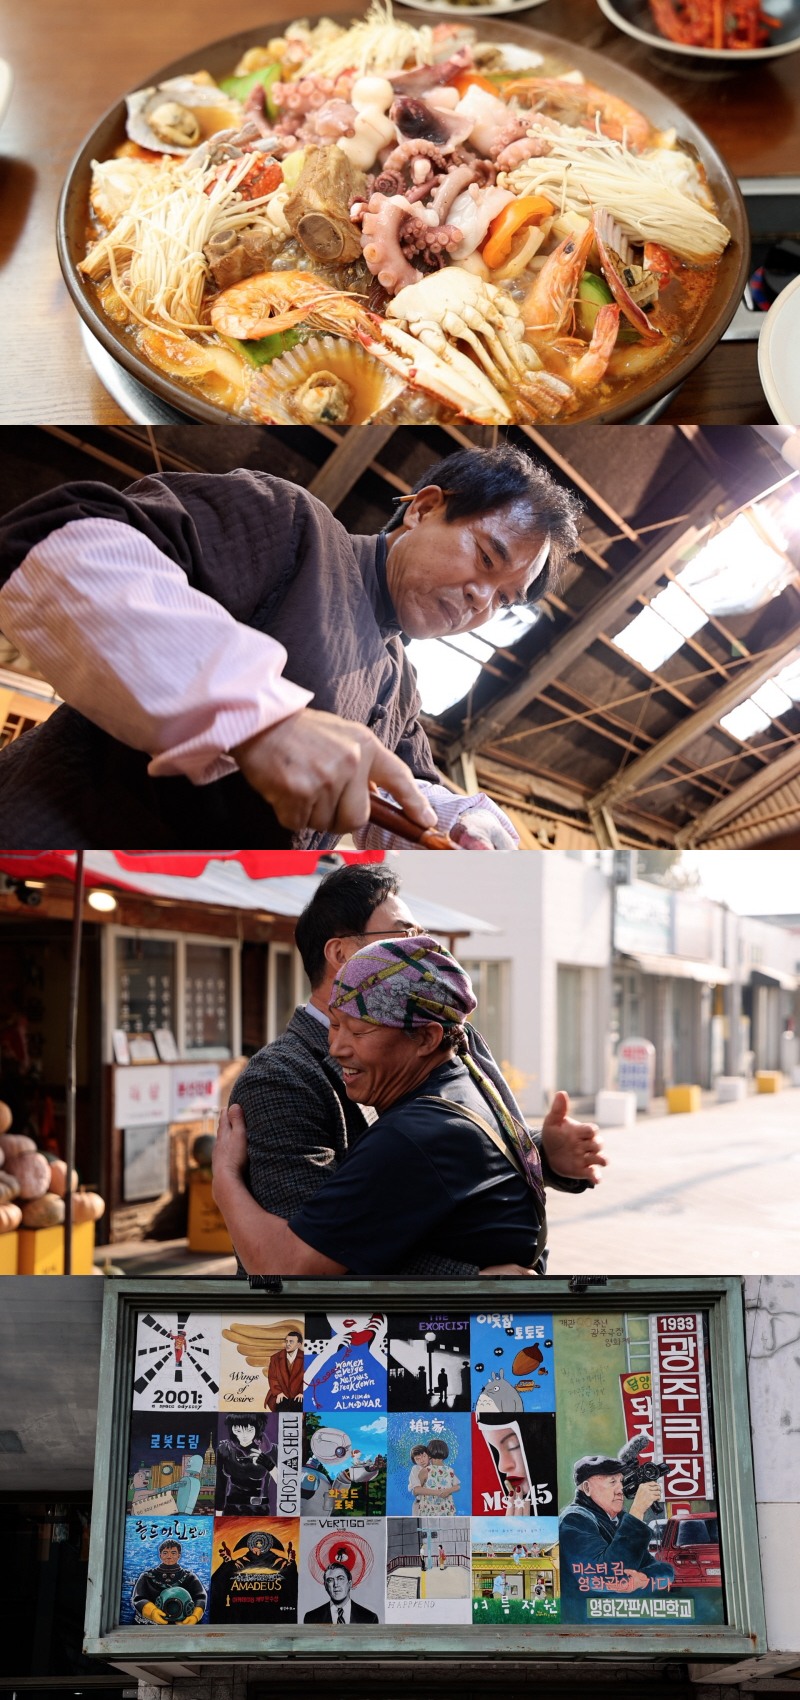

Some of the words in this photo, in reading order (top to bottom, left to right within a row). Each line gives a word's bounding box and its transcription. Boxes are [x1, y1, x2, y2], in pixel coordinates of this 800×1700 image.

[418, 1321, 470, 1331] EXORCIST
[476, 1313, 514, 1329] 이웃집
[559, 1318, 576, 1329] 개관
[660, 1316, 694, 1331] 1933
[514, 1325, 545, 1340] 토토로
[591, 1327, 624, 1338] 광주극장
[229, 1371, 260, 1384] Wings
[152, 1389, 203, 1404] 2001:
[238, 1384, 250, 1395] of
[223, 1393, 254, 1403] Desire
[659, 1336, 701, 1496] 광주극장
[410, 1417, 447, 1434] 搬家
[150, 1433, 199, 1450] 로봇드림
[282, 1416, 299, 1456] SHELL
[278, 1469, 298, 1514] GHOST
[523, 1483, 553, 1506] 45
[333, 1499, 354, 1510] 로봇
[318, 1518, 365, 1529] VERTIGO
[572, 1562, 608, 1575] 미스터
[611, 1561, 625, 1576] 김
[230, 1578, 282, 1591] AMADEUS
[578, 1576, 635, 1592] 영화관에
[589, 1598, 692, 1618] 영화간판시민학교
